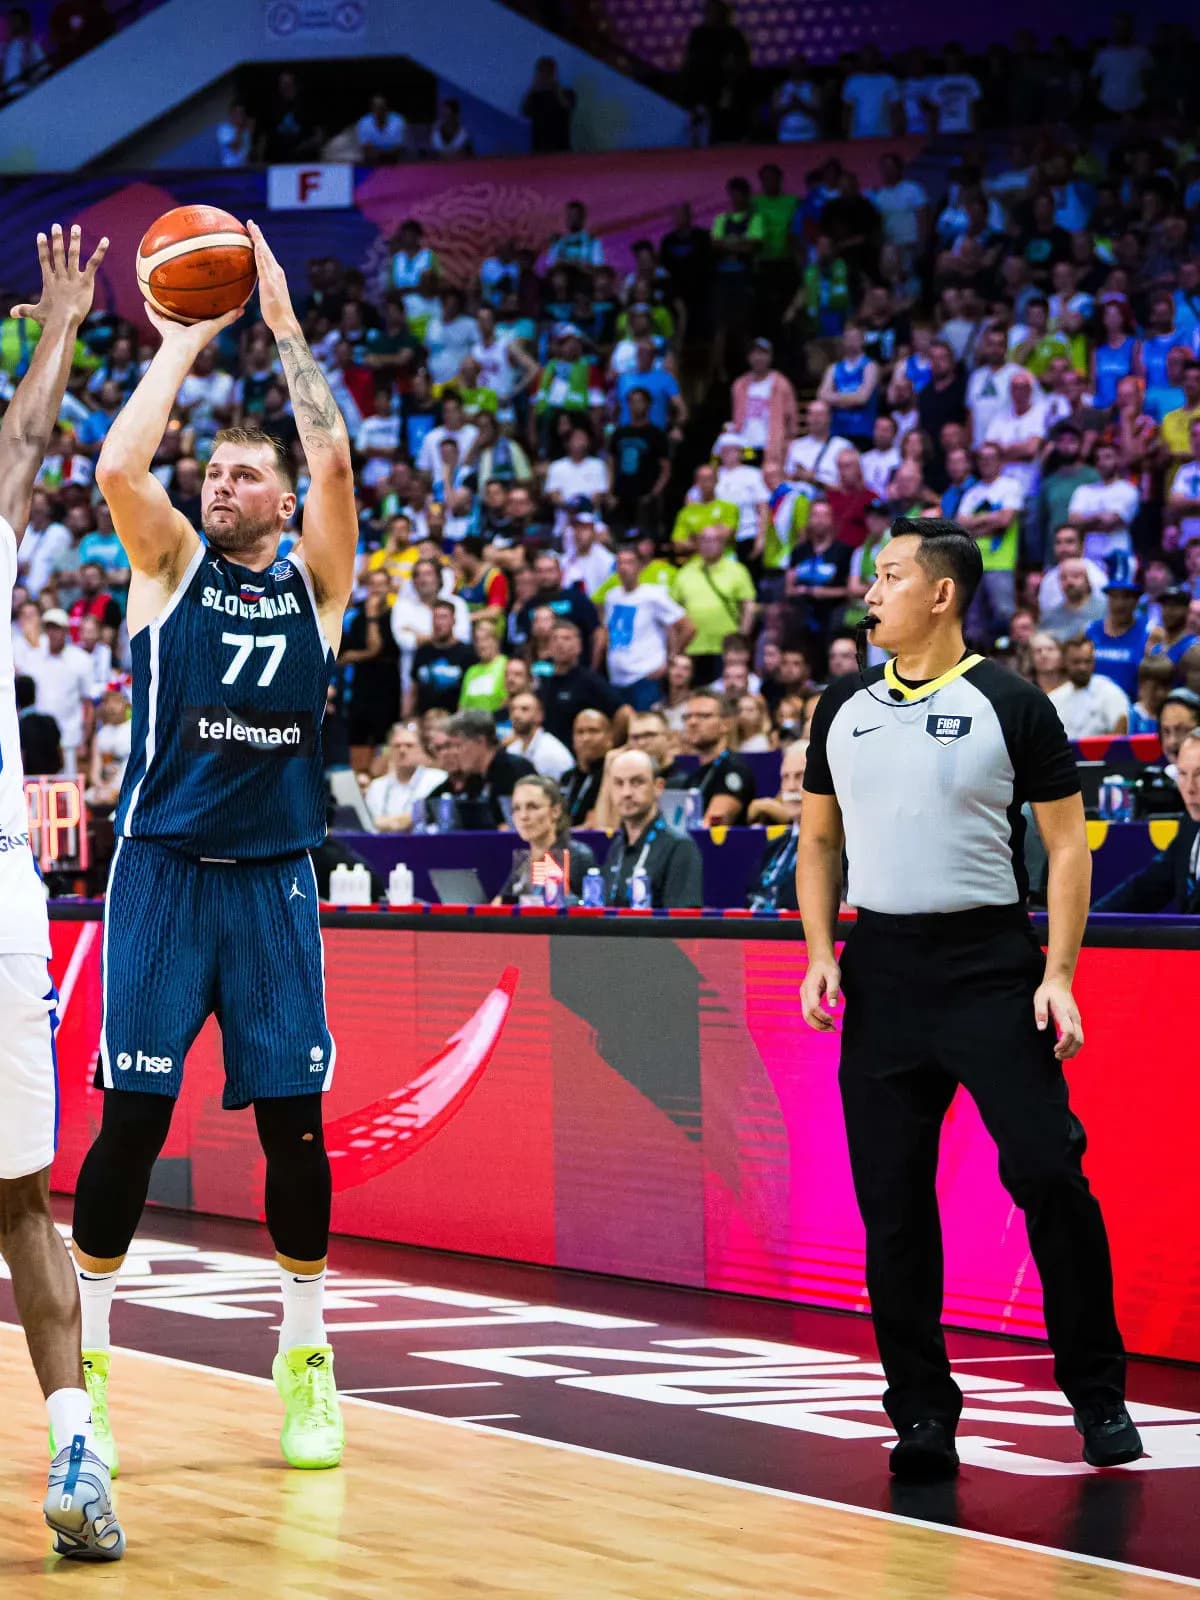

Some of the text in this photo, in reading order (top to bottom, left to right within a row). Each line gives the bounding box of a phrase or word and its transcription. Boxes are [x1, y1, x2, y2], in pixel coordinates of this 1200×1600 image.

[298, 170, 322, 202] F
[201, 586, 301, 619] SLOVENIJA
[221, 632, 287, 687] 77
[198, 717, 301, 745] telemach
[937, 718, 960, 729] FIBA
[135, 1050, 173, 1073] hse
[309, 1062, 324, 1073] KZS
